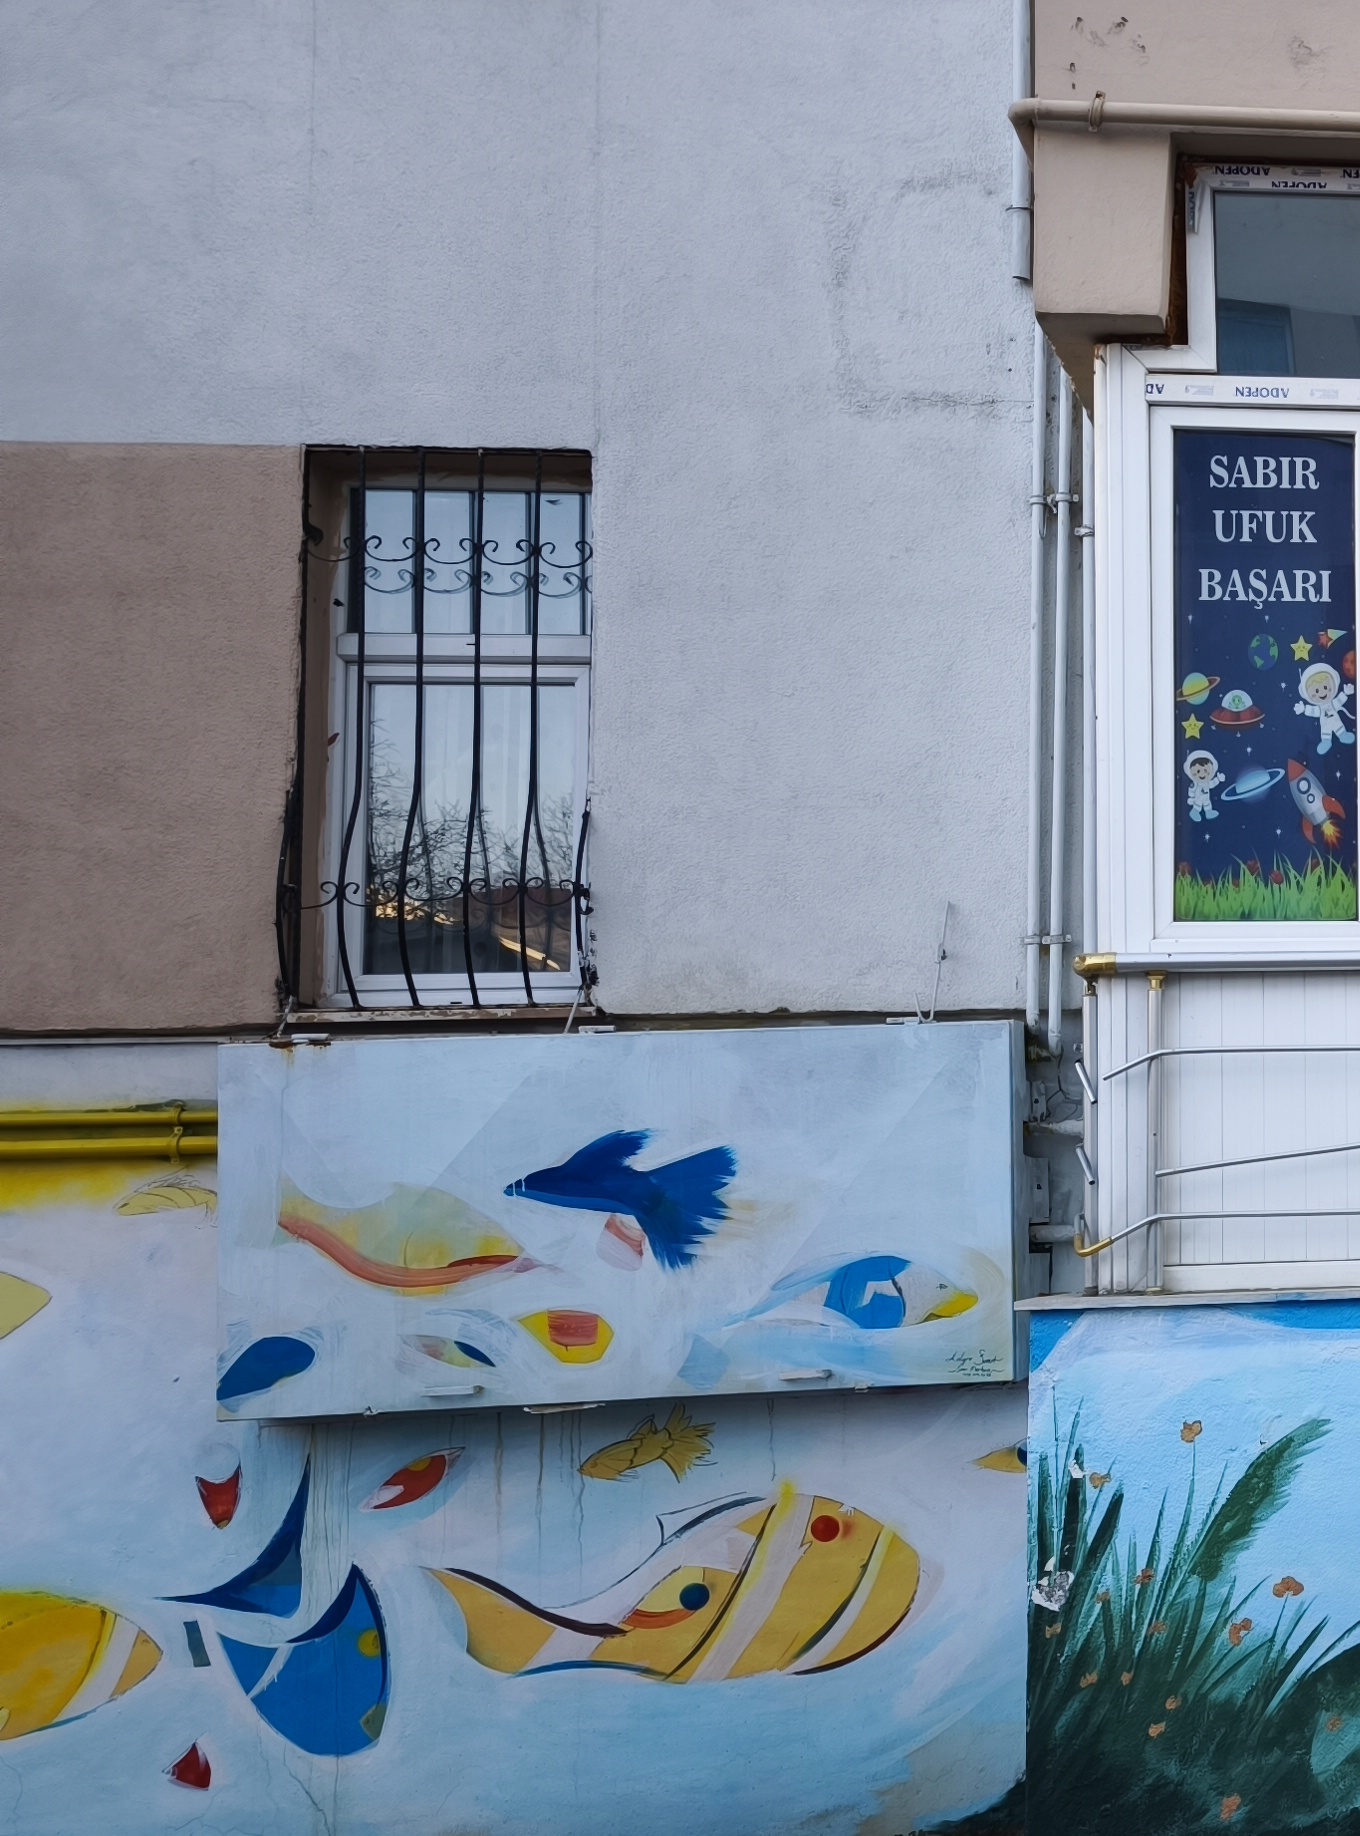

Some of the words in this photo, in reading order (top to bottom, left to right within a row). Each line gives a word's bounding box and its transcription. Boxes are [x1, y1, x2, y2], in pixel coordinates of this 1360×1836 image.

[1214, 164, 1271, 177] ADOPEN
[1235, 386, 1290, 399] ADOPEN
[1209, 454, 1320, 490] SABIR
[1212, 509, 1318, 543] UFUK
[1198, 568, 1332, 609] BAŞARI
